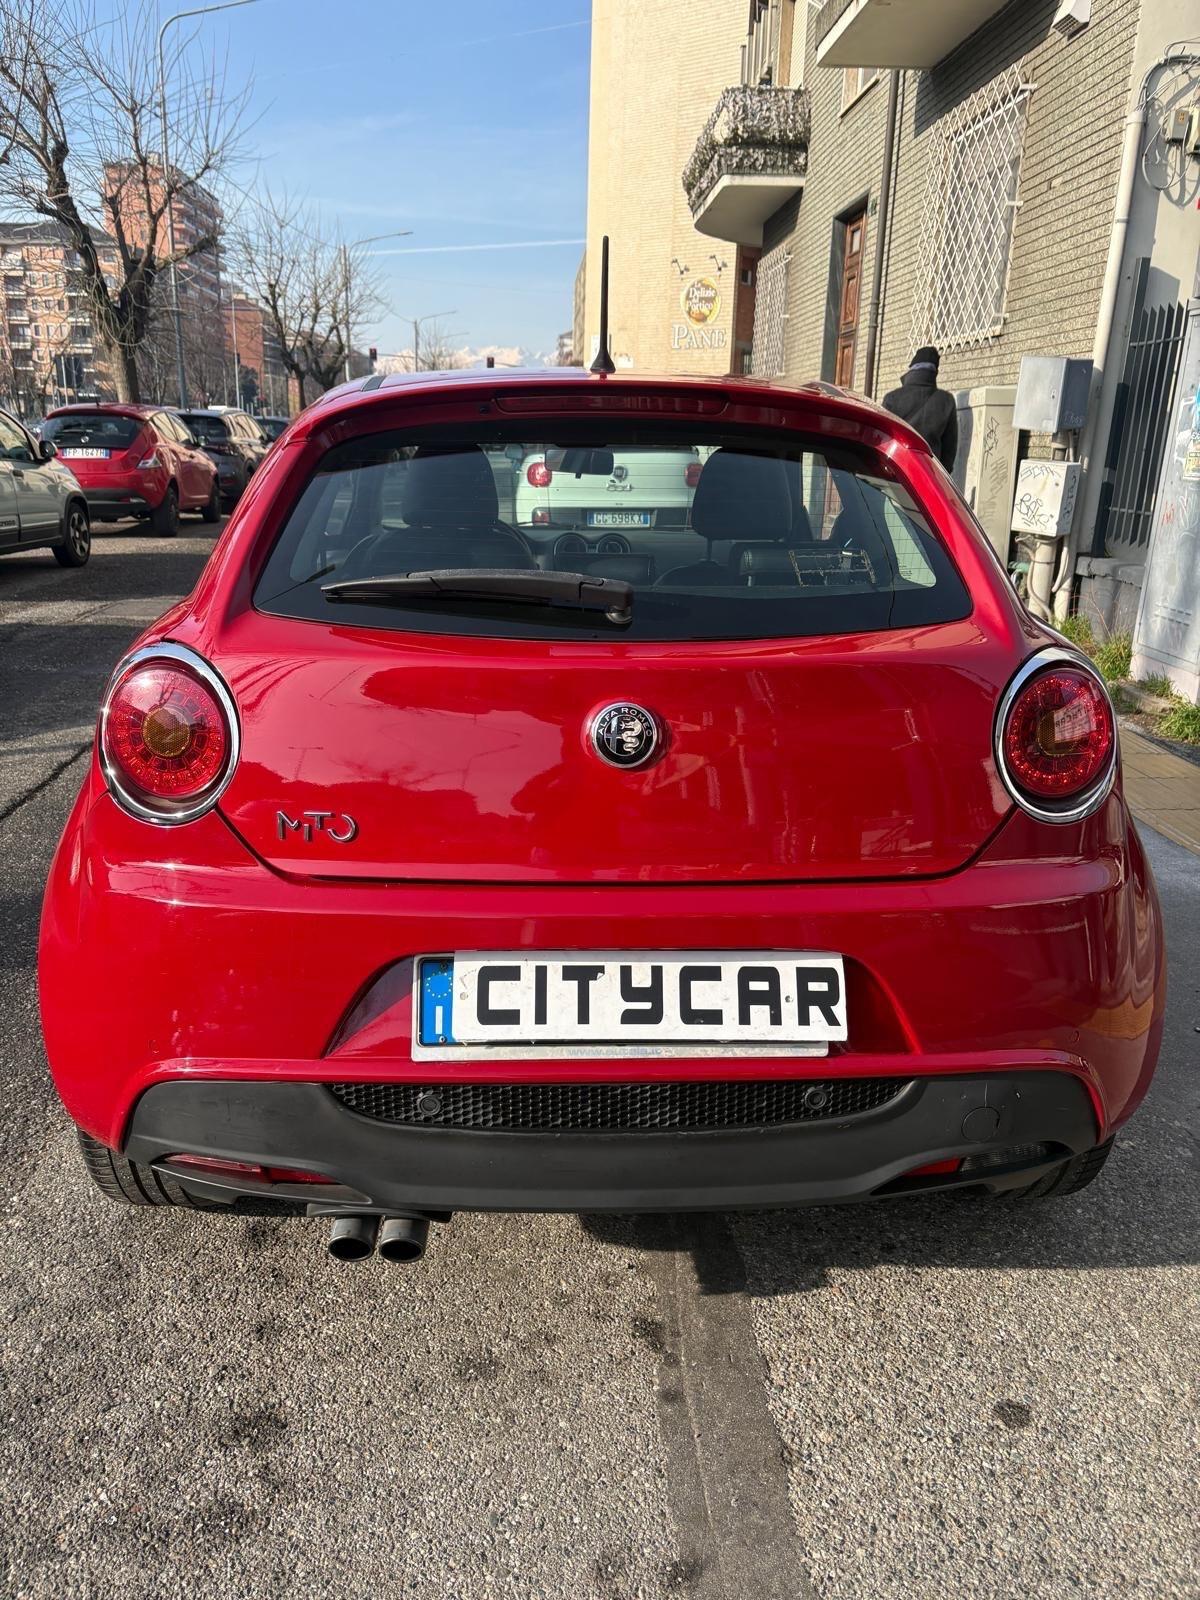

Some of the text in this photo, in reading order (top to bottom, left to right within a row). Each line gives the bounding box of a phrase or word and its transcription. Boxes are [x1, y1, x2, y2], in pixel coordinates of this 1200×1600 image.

[686, 300, 713, 311] Portico
[689, 287, 716, 298] Delizie
[671, 323, 727, 350] PANE
[598, 707, 653, 737] ALFA ROMEO
[476, 964, 842, 1027] CITYCAR
